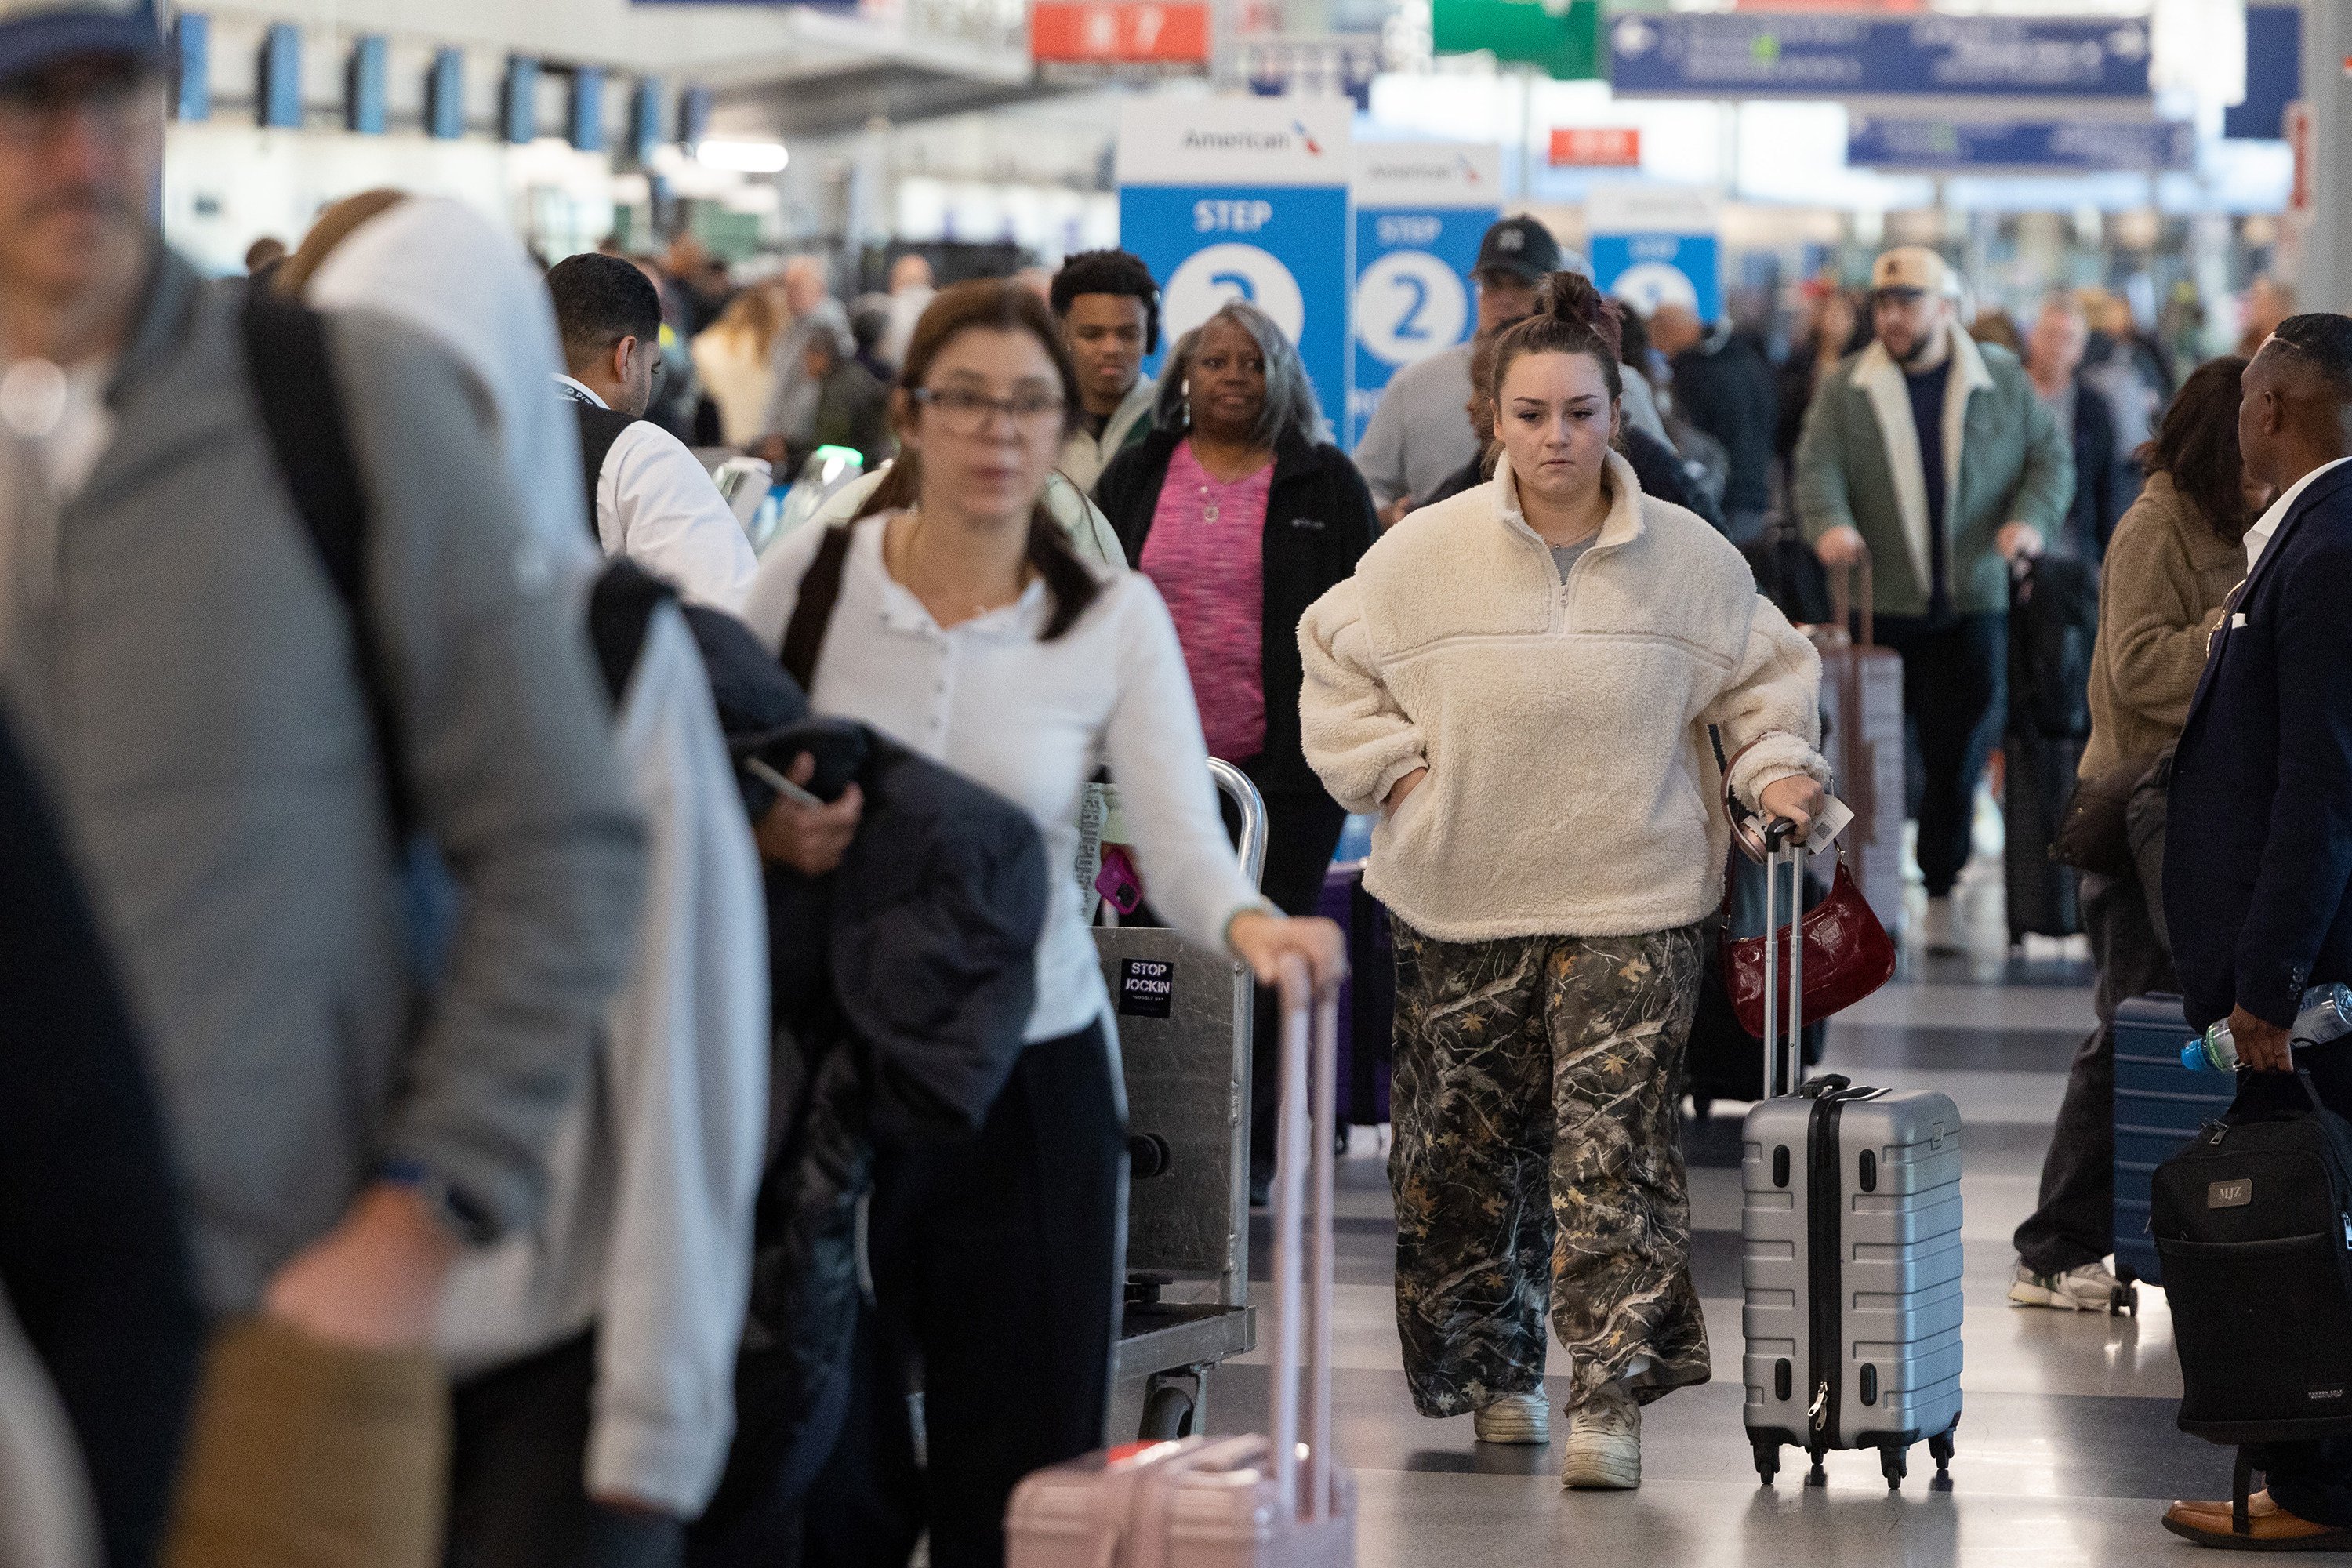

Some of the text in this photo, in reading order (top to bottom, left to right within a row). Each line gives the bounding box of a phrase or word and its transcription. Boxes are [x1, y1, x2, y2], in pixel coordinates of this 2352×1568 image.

[1192, 200, 1272, 232] STEP
[1392, 274, 1430, 341] 2
[1131, 963, 1167, 976] STOP
[1126, 978, 1170, 994] JOCKIN
